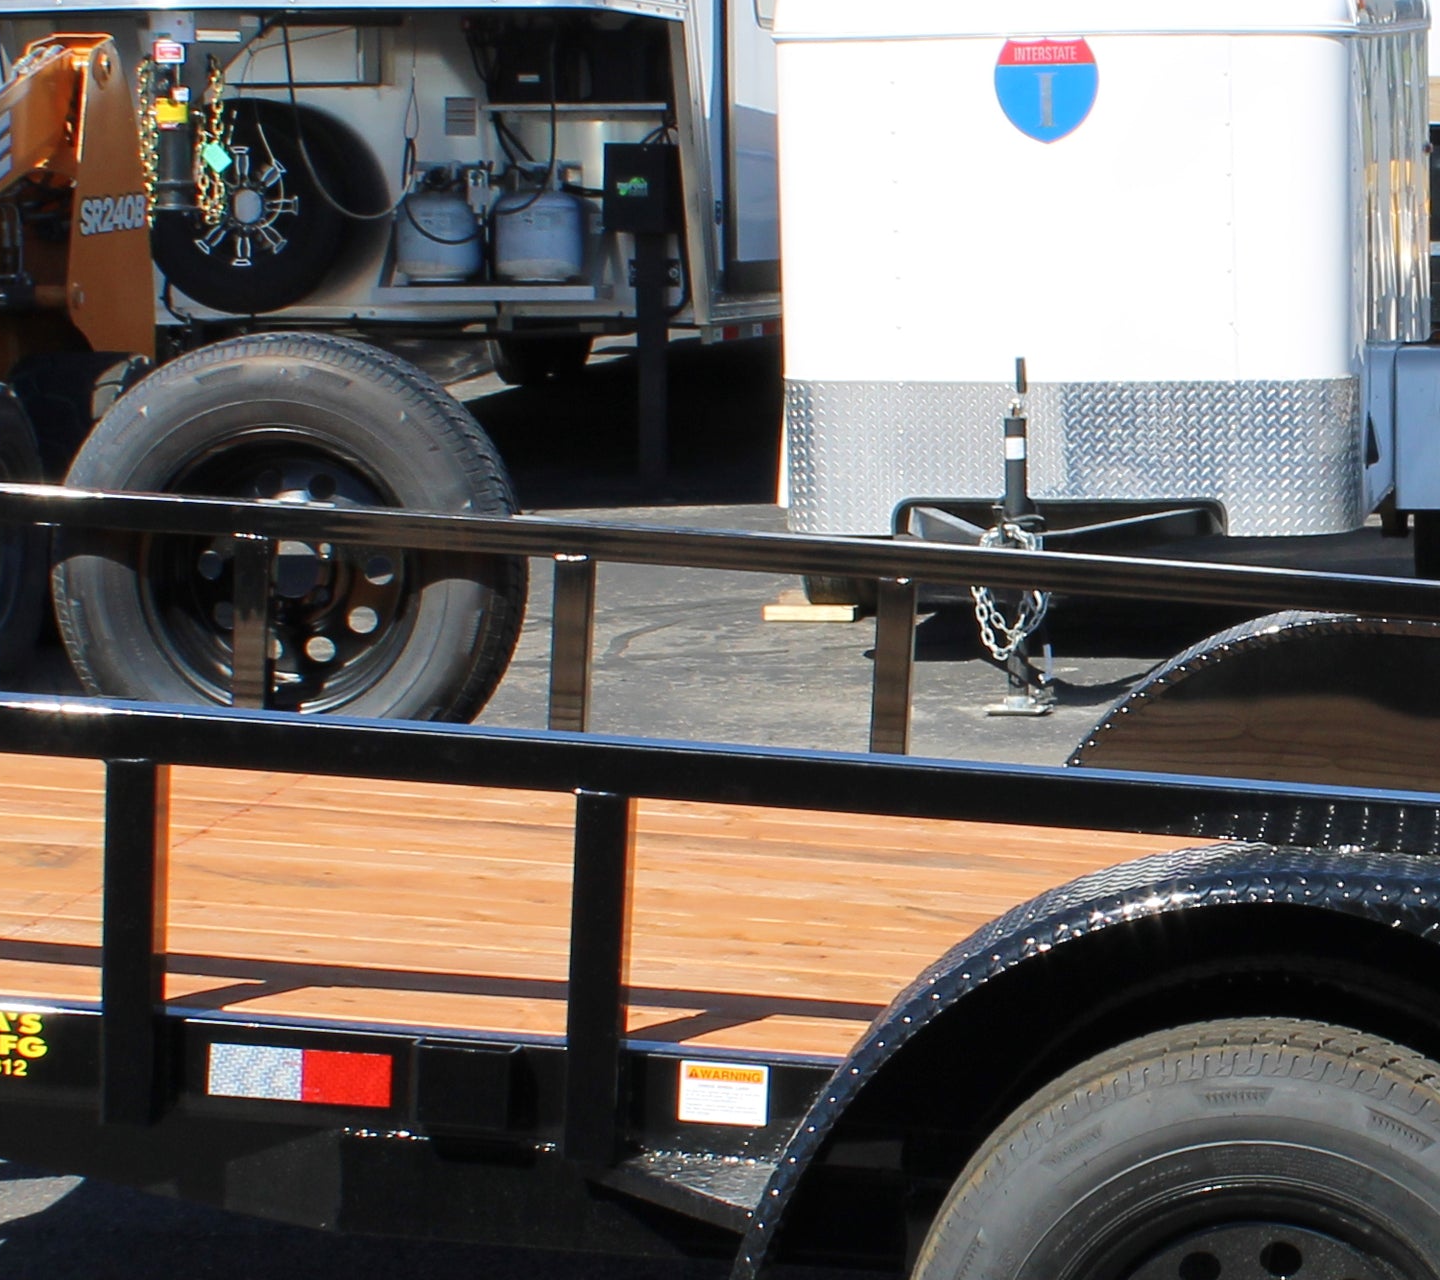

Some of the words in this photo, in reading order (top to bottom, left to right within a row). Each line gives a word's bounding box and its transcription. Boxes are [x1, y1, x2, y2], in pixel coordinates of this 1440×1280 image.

[1013, 46, 1077, 61] INTERSTATE
[80, 194, 146, 236] SR240B
[700, 1068, 761, 1083] WARNING
